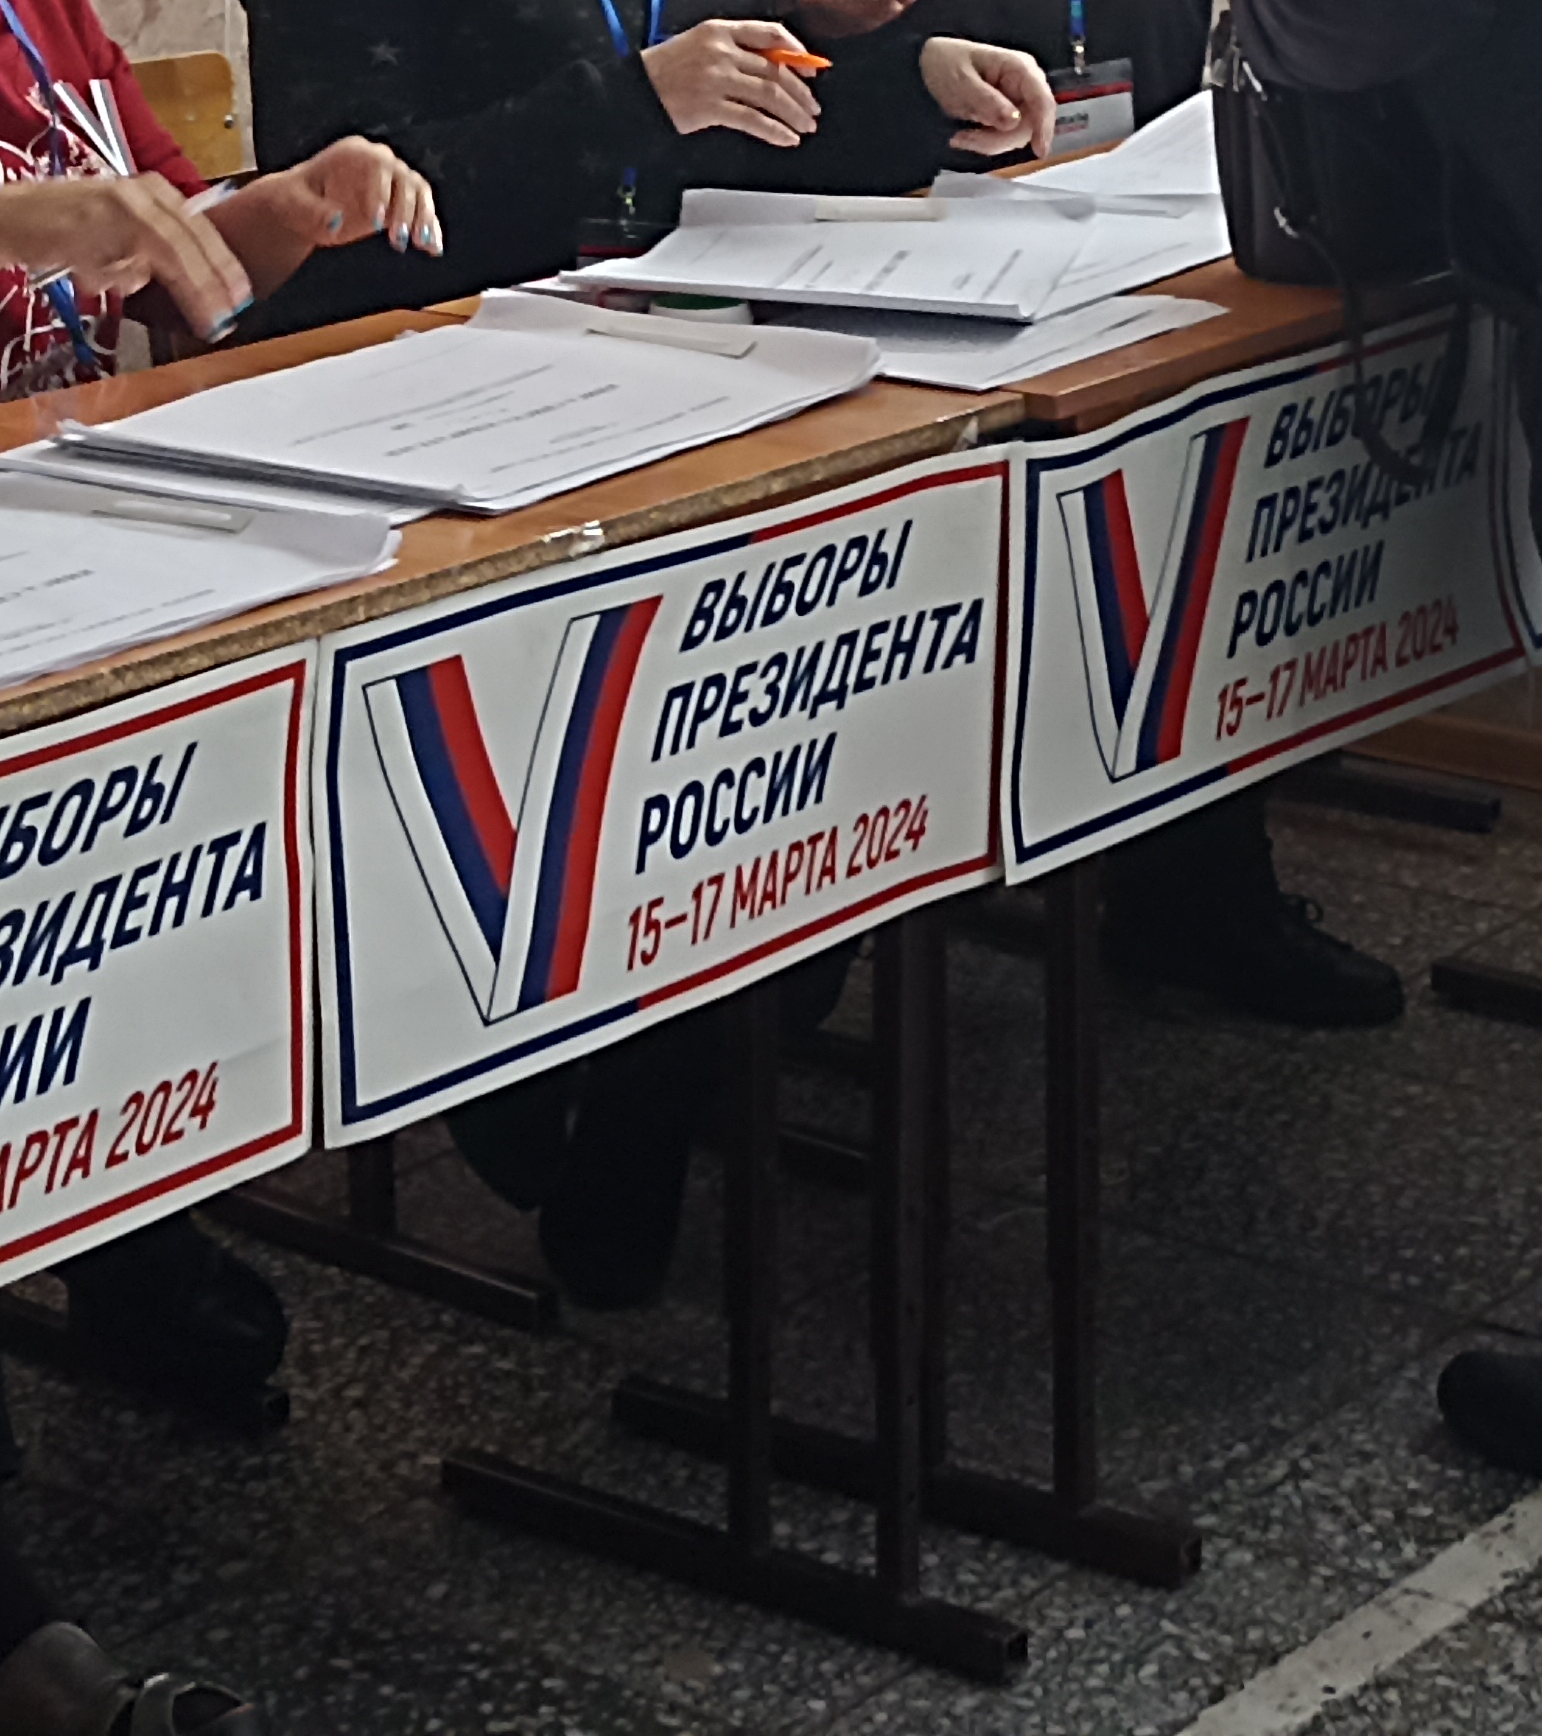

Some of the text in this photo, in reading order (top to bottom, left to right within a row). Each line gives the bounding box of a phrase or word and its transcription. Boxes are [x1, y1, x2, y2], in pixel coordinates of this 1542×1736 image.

[678, 518, 914, 654] ВЫБОРЫ
[1226, 539, 1385, 660] РОССИИ
[650, 596, 986, 763] ПРЕЗИДЕНТА
[1297, 625, 1388, 709] МАРТА
[1394, 598, 1458, 671] 2024
[634, 730, 838, 876] РОССИИ
[727, 824, 838, 928] МАРТА
[845, 794, 930, 880] 2024
[105, 1060, 220, 1171] 2024
